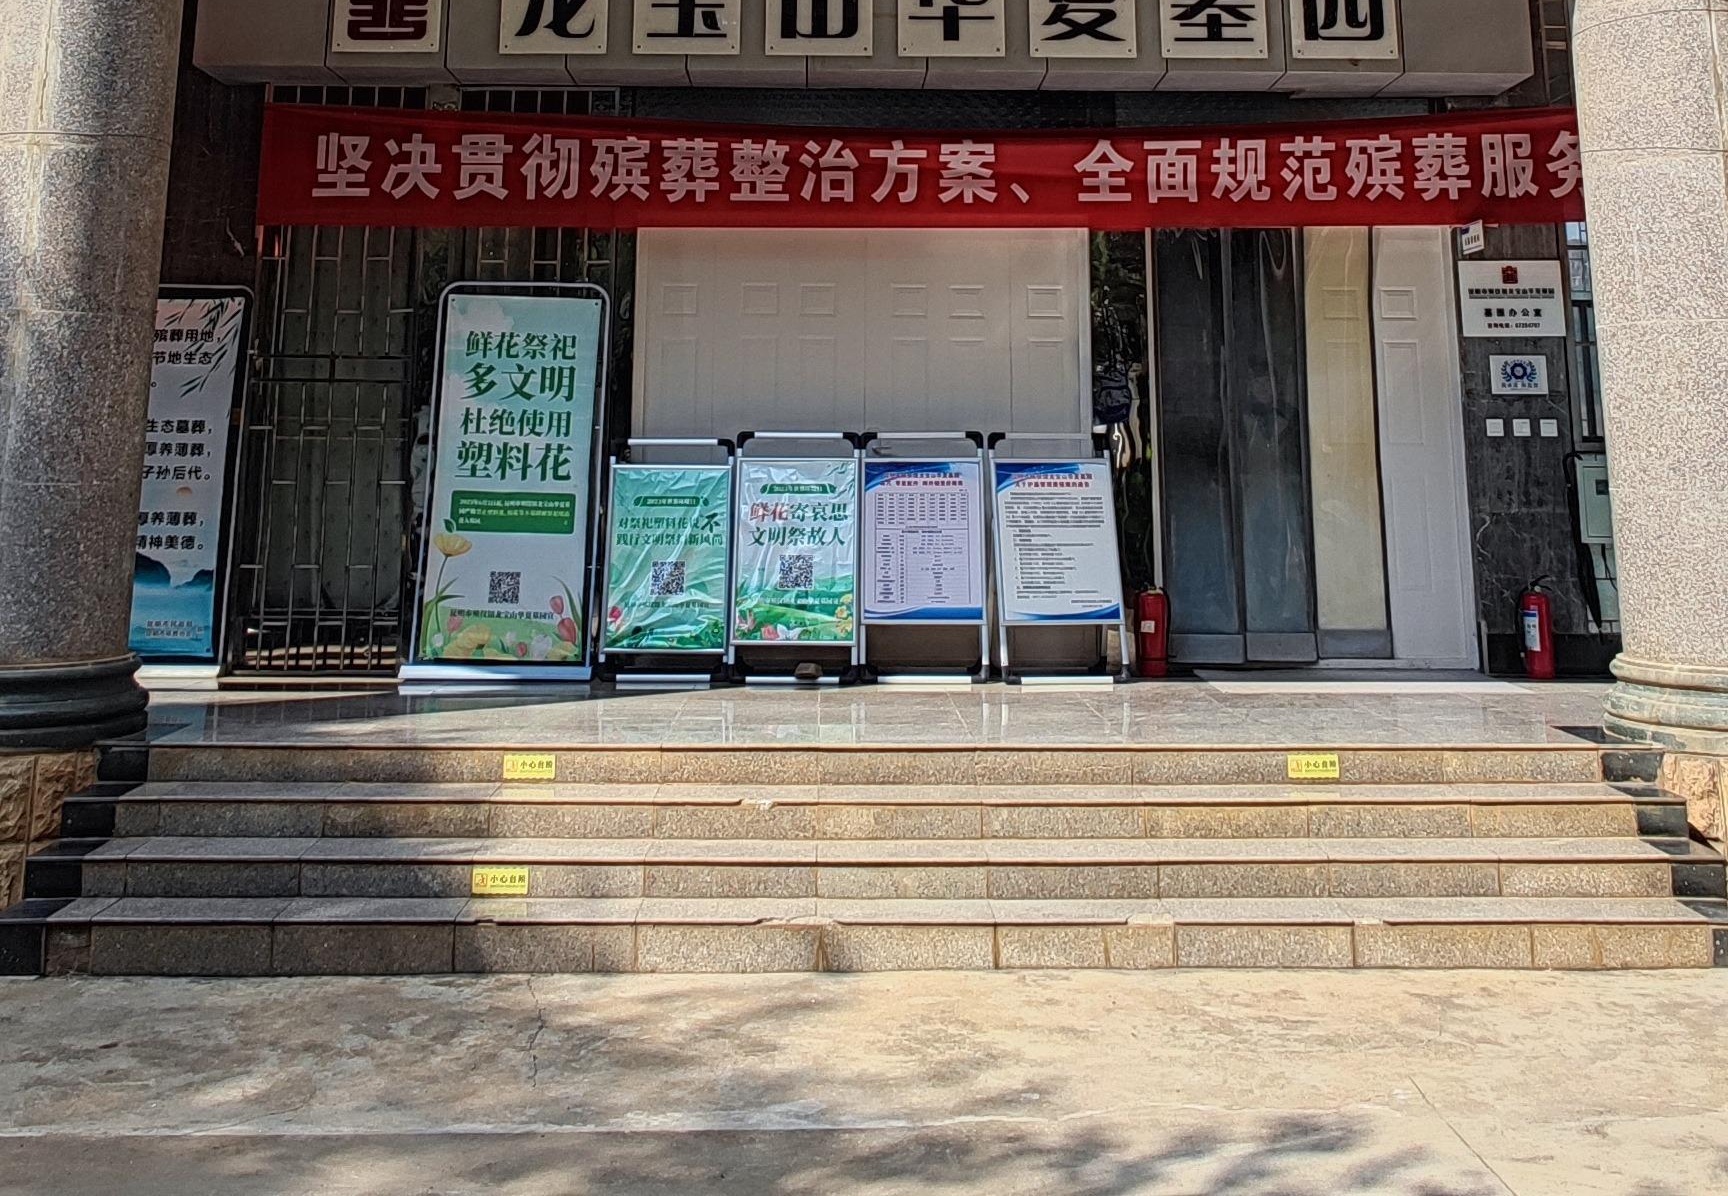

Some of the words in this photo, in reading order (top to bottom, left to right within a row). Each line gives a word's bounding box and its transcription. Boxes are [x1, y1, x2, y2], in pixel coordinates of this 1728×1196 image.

[312, 130, 1584, 206] 坚决贯彻殡葬整治方案、全面规范殡葬服务
[1484, 308, 1542, 317] 墓园办公室
[152, 351, 213, 365] 节地生态
[465, 330, 578, 361] 鲜花祭祀
[460, 361, 577, 402] 多文明
[459, 406, 573, 440] 杜绝使用
[454, 440, 573, 483] 塑料花
[749, 502, 849, 523] 鲜花寄哀思
[747, 526, 846, 546] 文明祭故人
